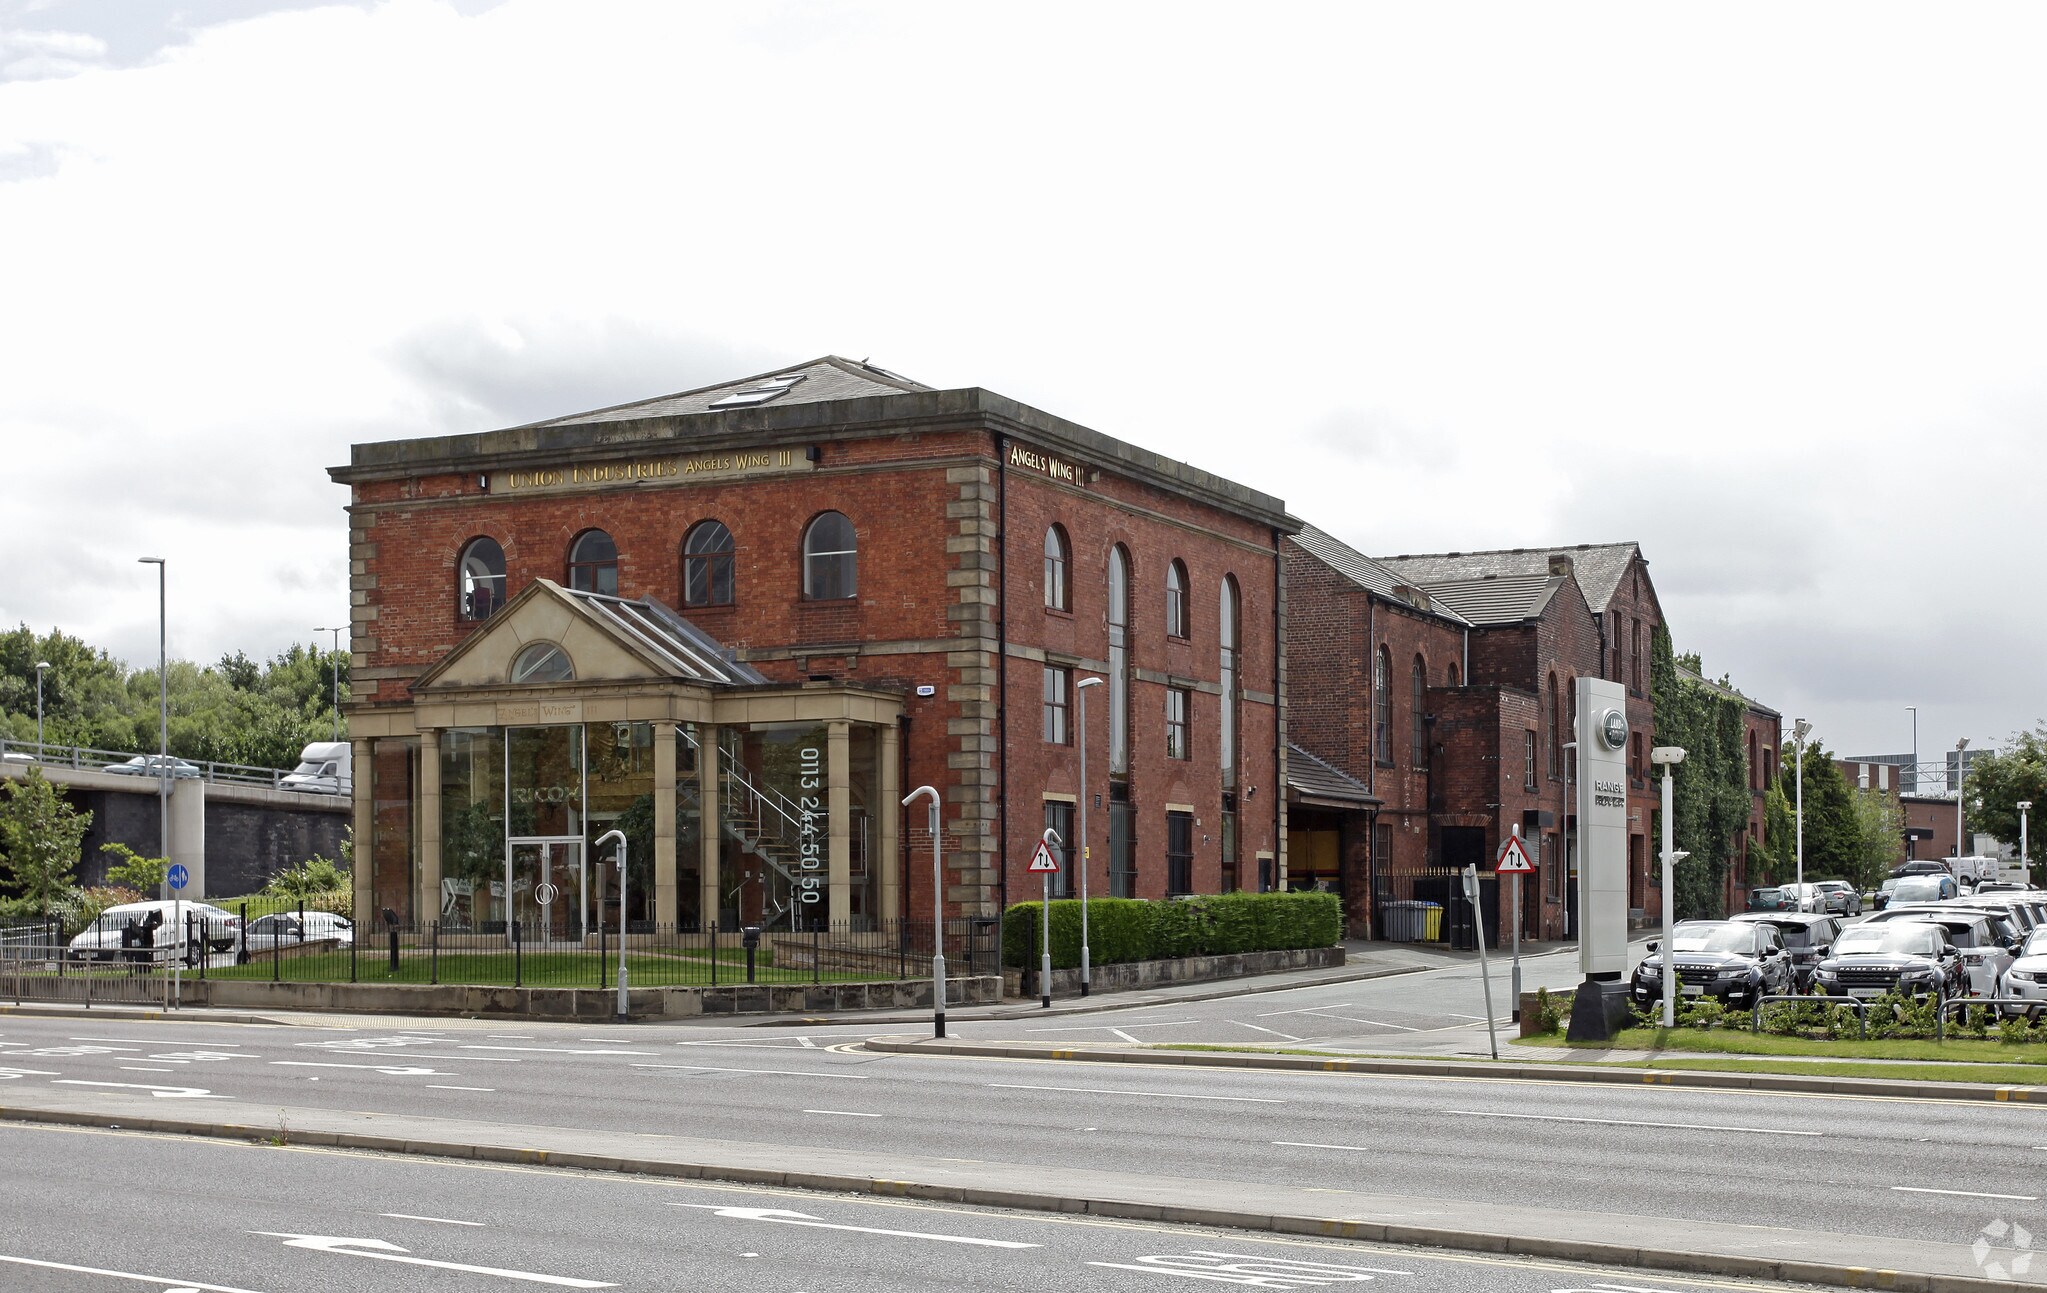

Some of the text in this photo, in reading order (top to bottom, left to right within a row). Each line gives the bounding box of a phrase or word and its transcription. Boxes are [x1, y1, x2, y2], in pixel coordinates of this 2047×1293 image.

[509, 467, 564, 488] UNION
[572, 461, 677, 484] INDUSTRIES
[685, 458, 730, 474] ANGEL'S
[735, 454, 769, 470] WING
[1011, 446, 1046, 471] ANGEL'S
[1048, 456, 1072, 480] WING
[541, 705, 575, 718] WING
[1595, 780, 1625, 793] RANGE
[801, 748, 820, 904] 0113 244 50 50
[1083, 1250, 1416, 1289] A61
